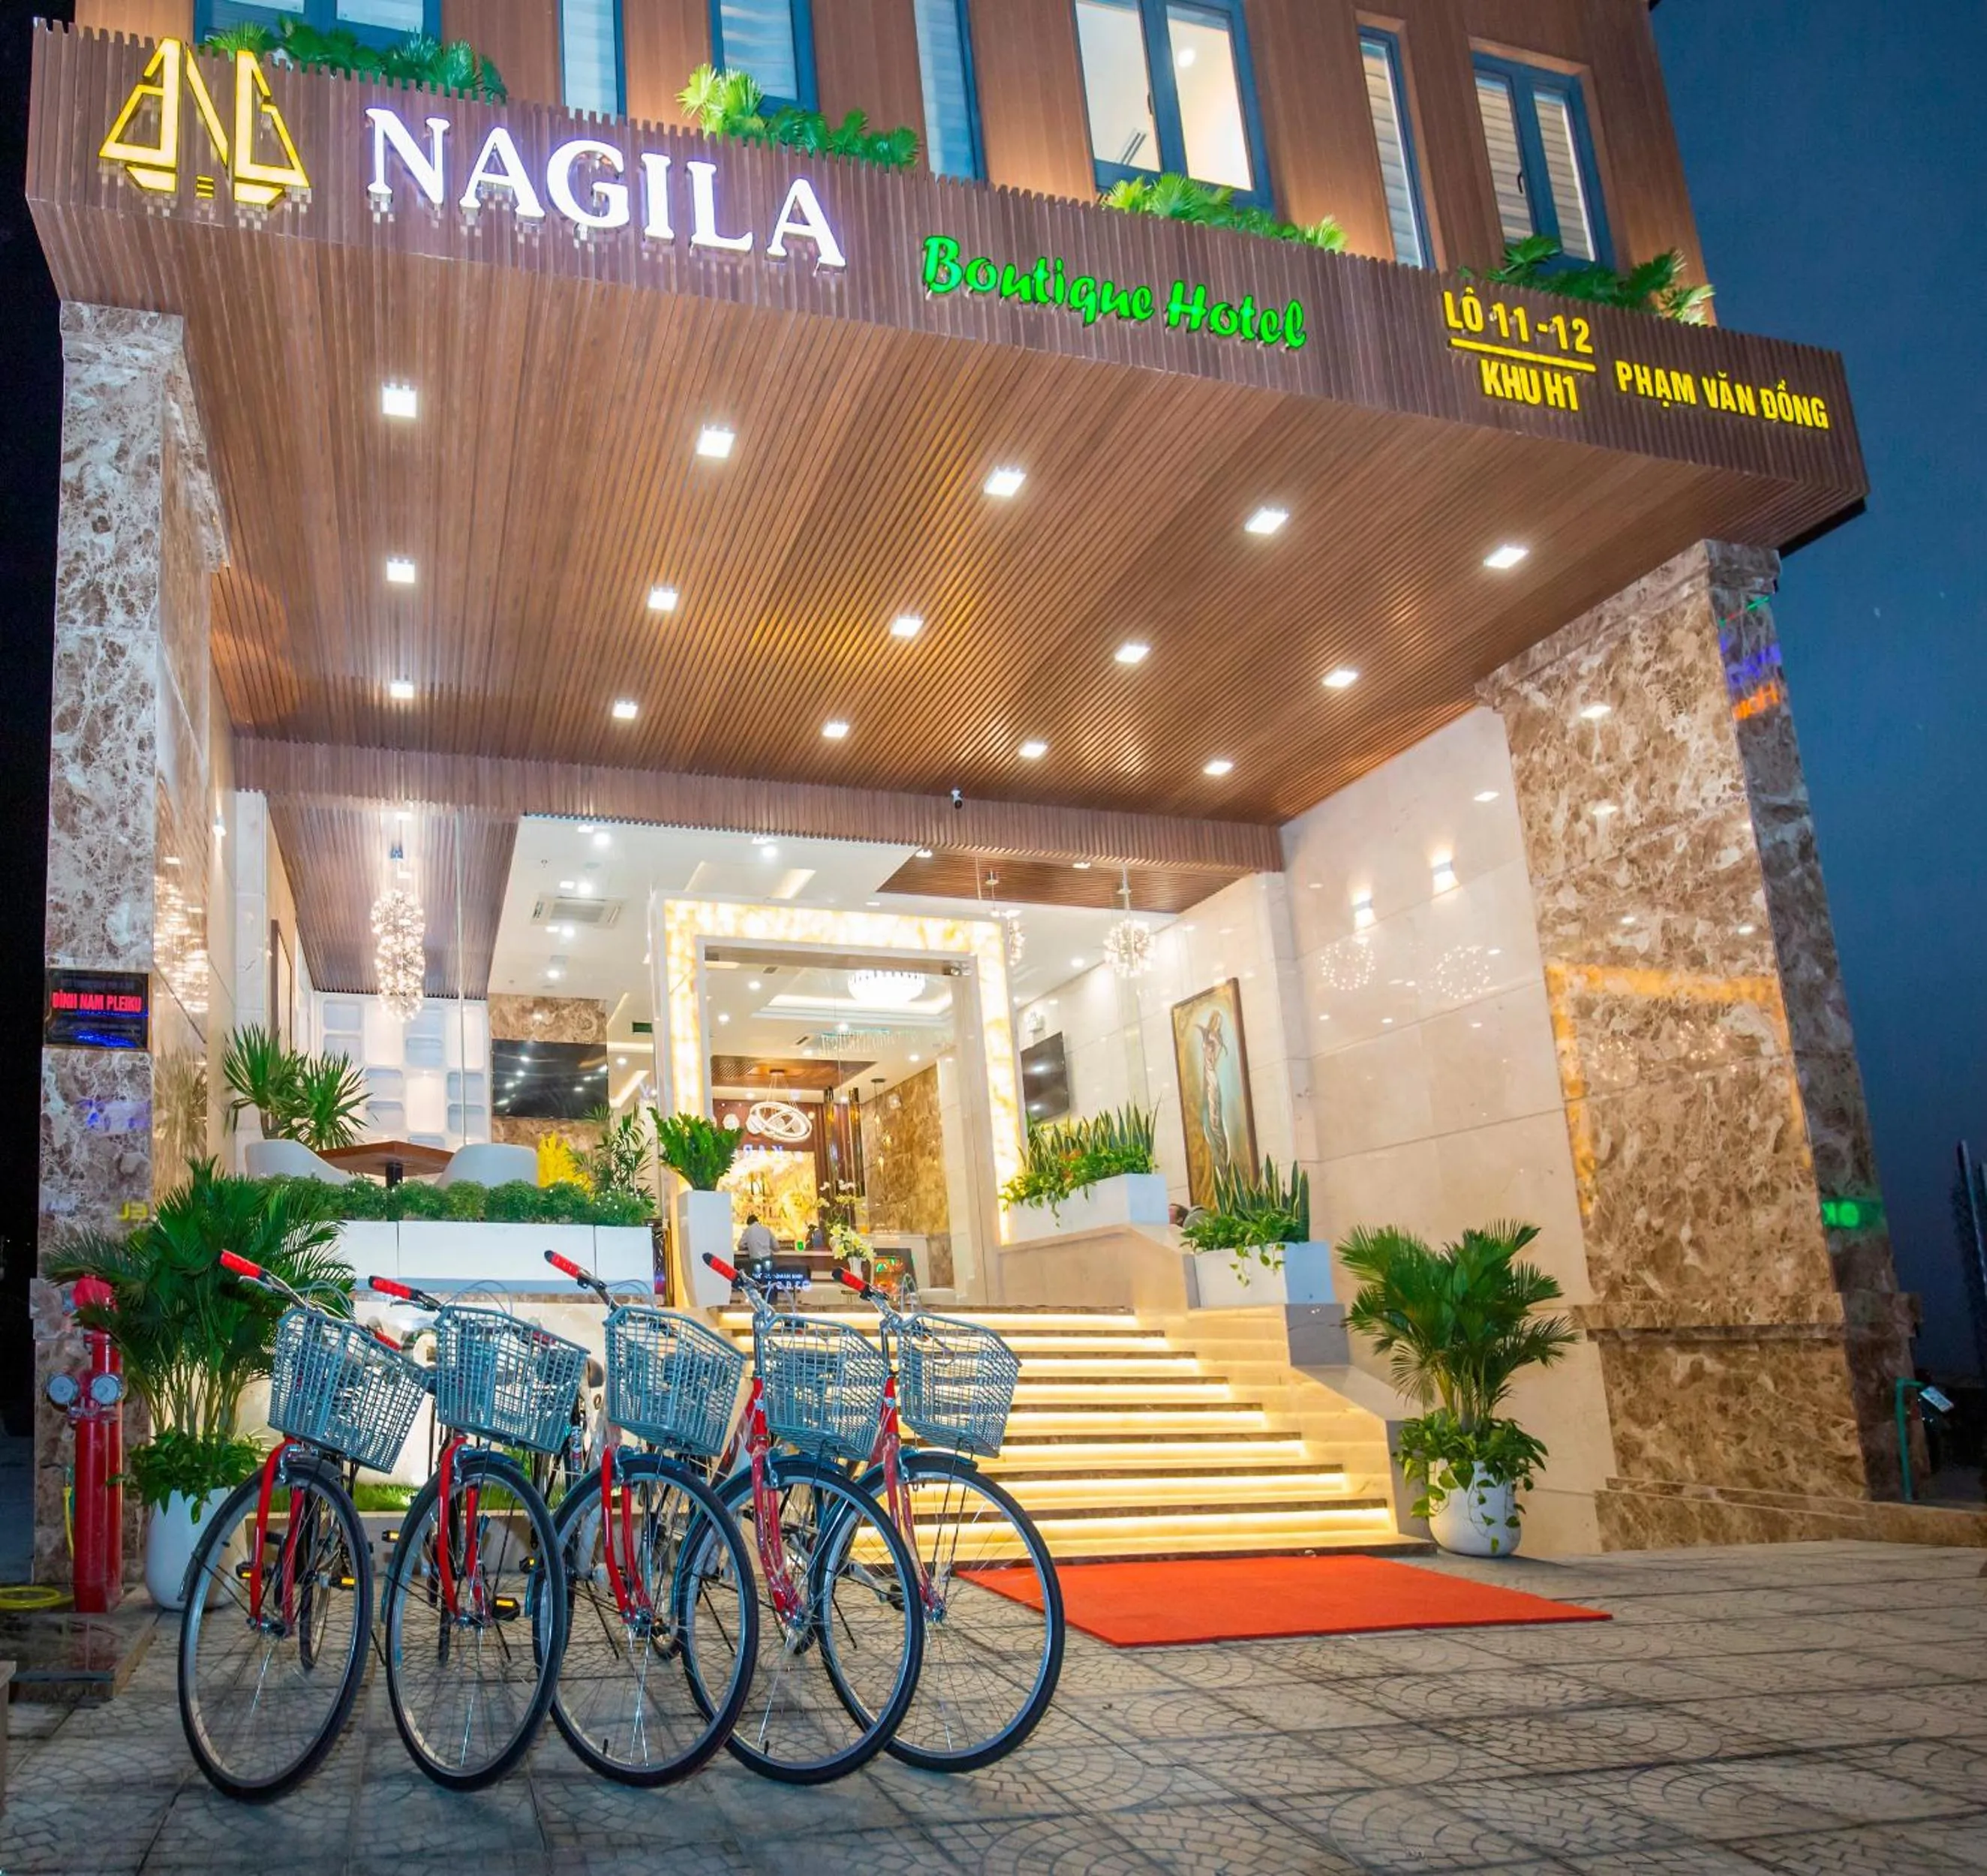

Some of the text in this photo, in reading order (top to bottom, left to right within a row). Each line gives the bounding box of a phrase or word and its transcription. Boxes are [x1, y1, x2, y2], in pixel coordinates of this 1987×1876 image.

[365, 107, 846, 267] NAGILA
[924, 235, 1306, 348] Boutique Hotel
[1443, 287, 1483, 332] LÔ
[1480, 358, 1579, 411] KHU H1
[1615, 360, 1829, 429] PHẠM VĂN ĐỒNG
[107, 994, 143, 1013] PLEIKU
